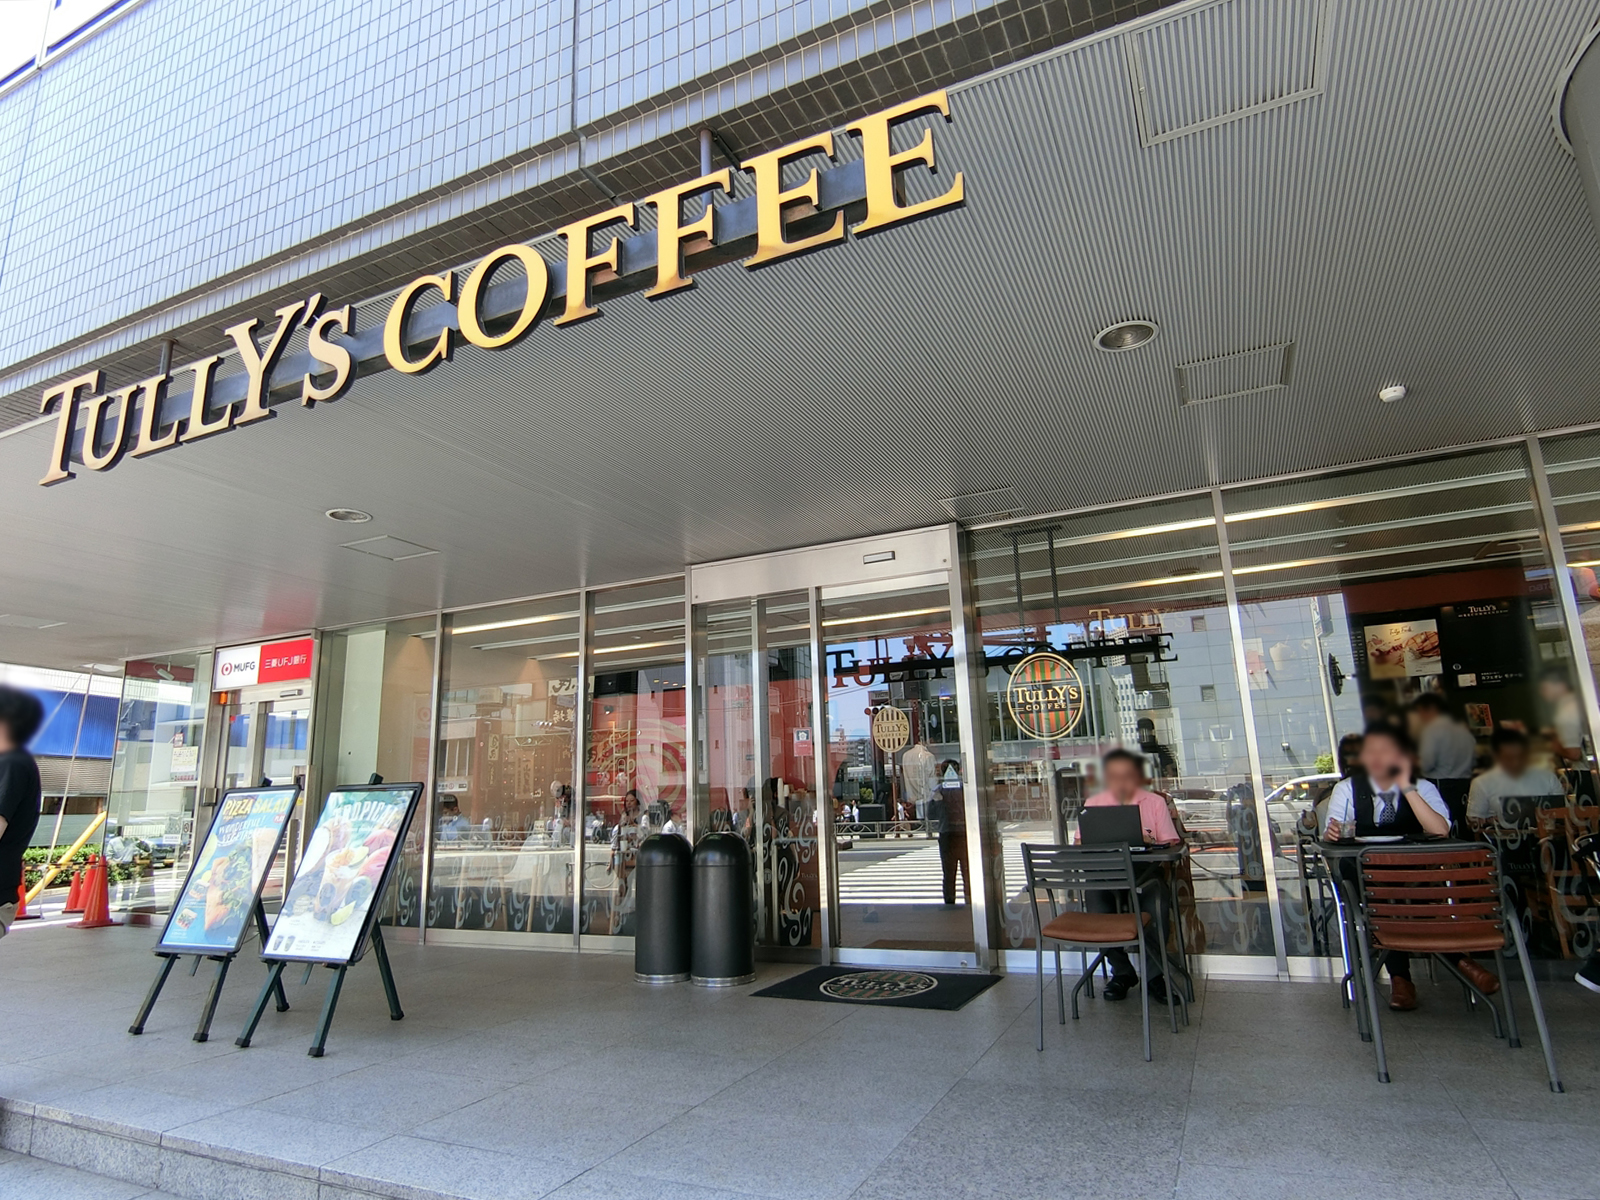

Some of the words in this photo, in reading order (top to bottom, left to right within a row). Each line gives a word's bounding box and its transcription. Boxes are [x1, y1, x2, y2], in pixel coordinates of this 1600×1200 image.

[38, 292, 357, 488] TULLY'S
[383, 90, 966, 376] COFFEE
[233, 661, 256, 672] MUFG
[264, 654, 307, 669] 三菱UFJ銀行
[1013, 683, 1079, 704] TULLY'S
[1025, 702, 1067, 711] COFFEE
[874, 723, 908, 733] TULLY'S
[222, 798, 254, 816] PIZZA
[252, 797, 290, 813] SALAD
